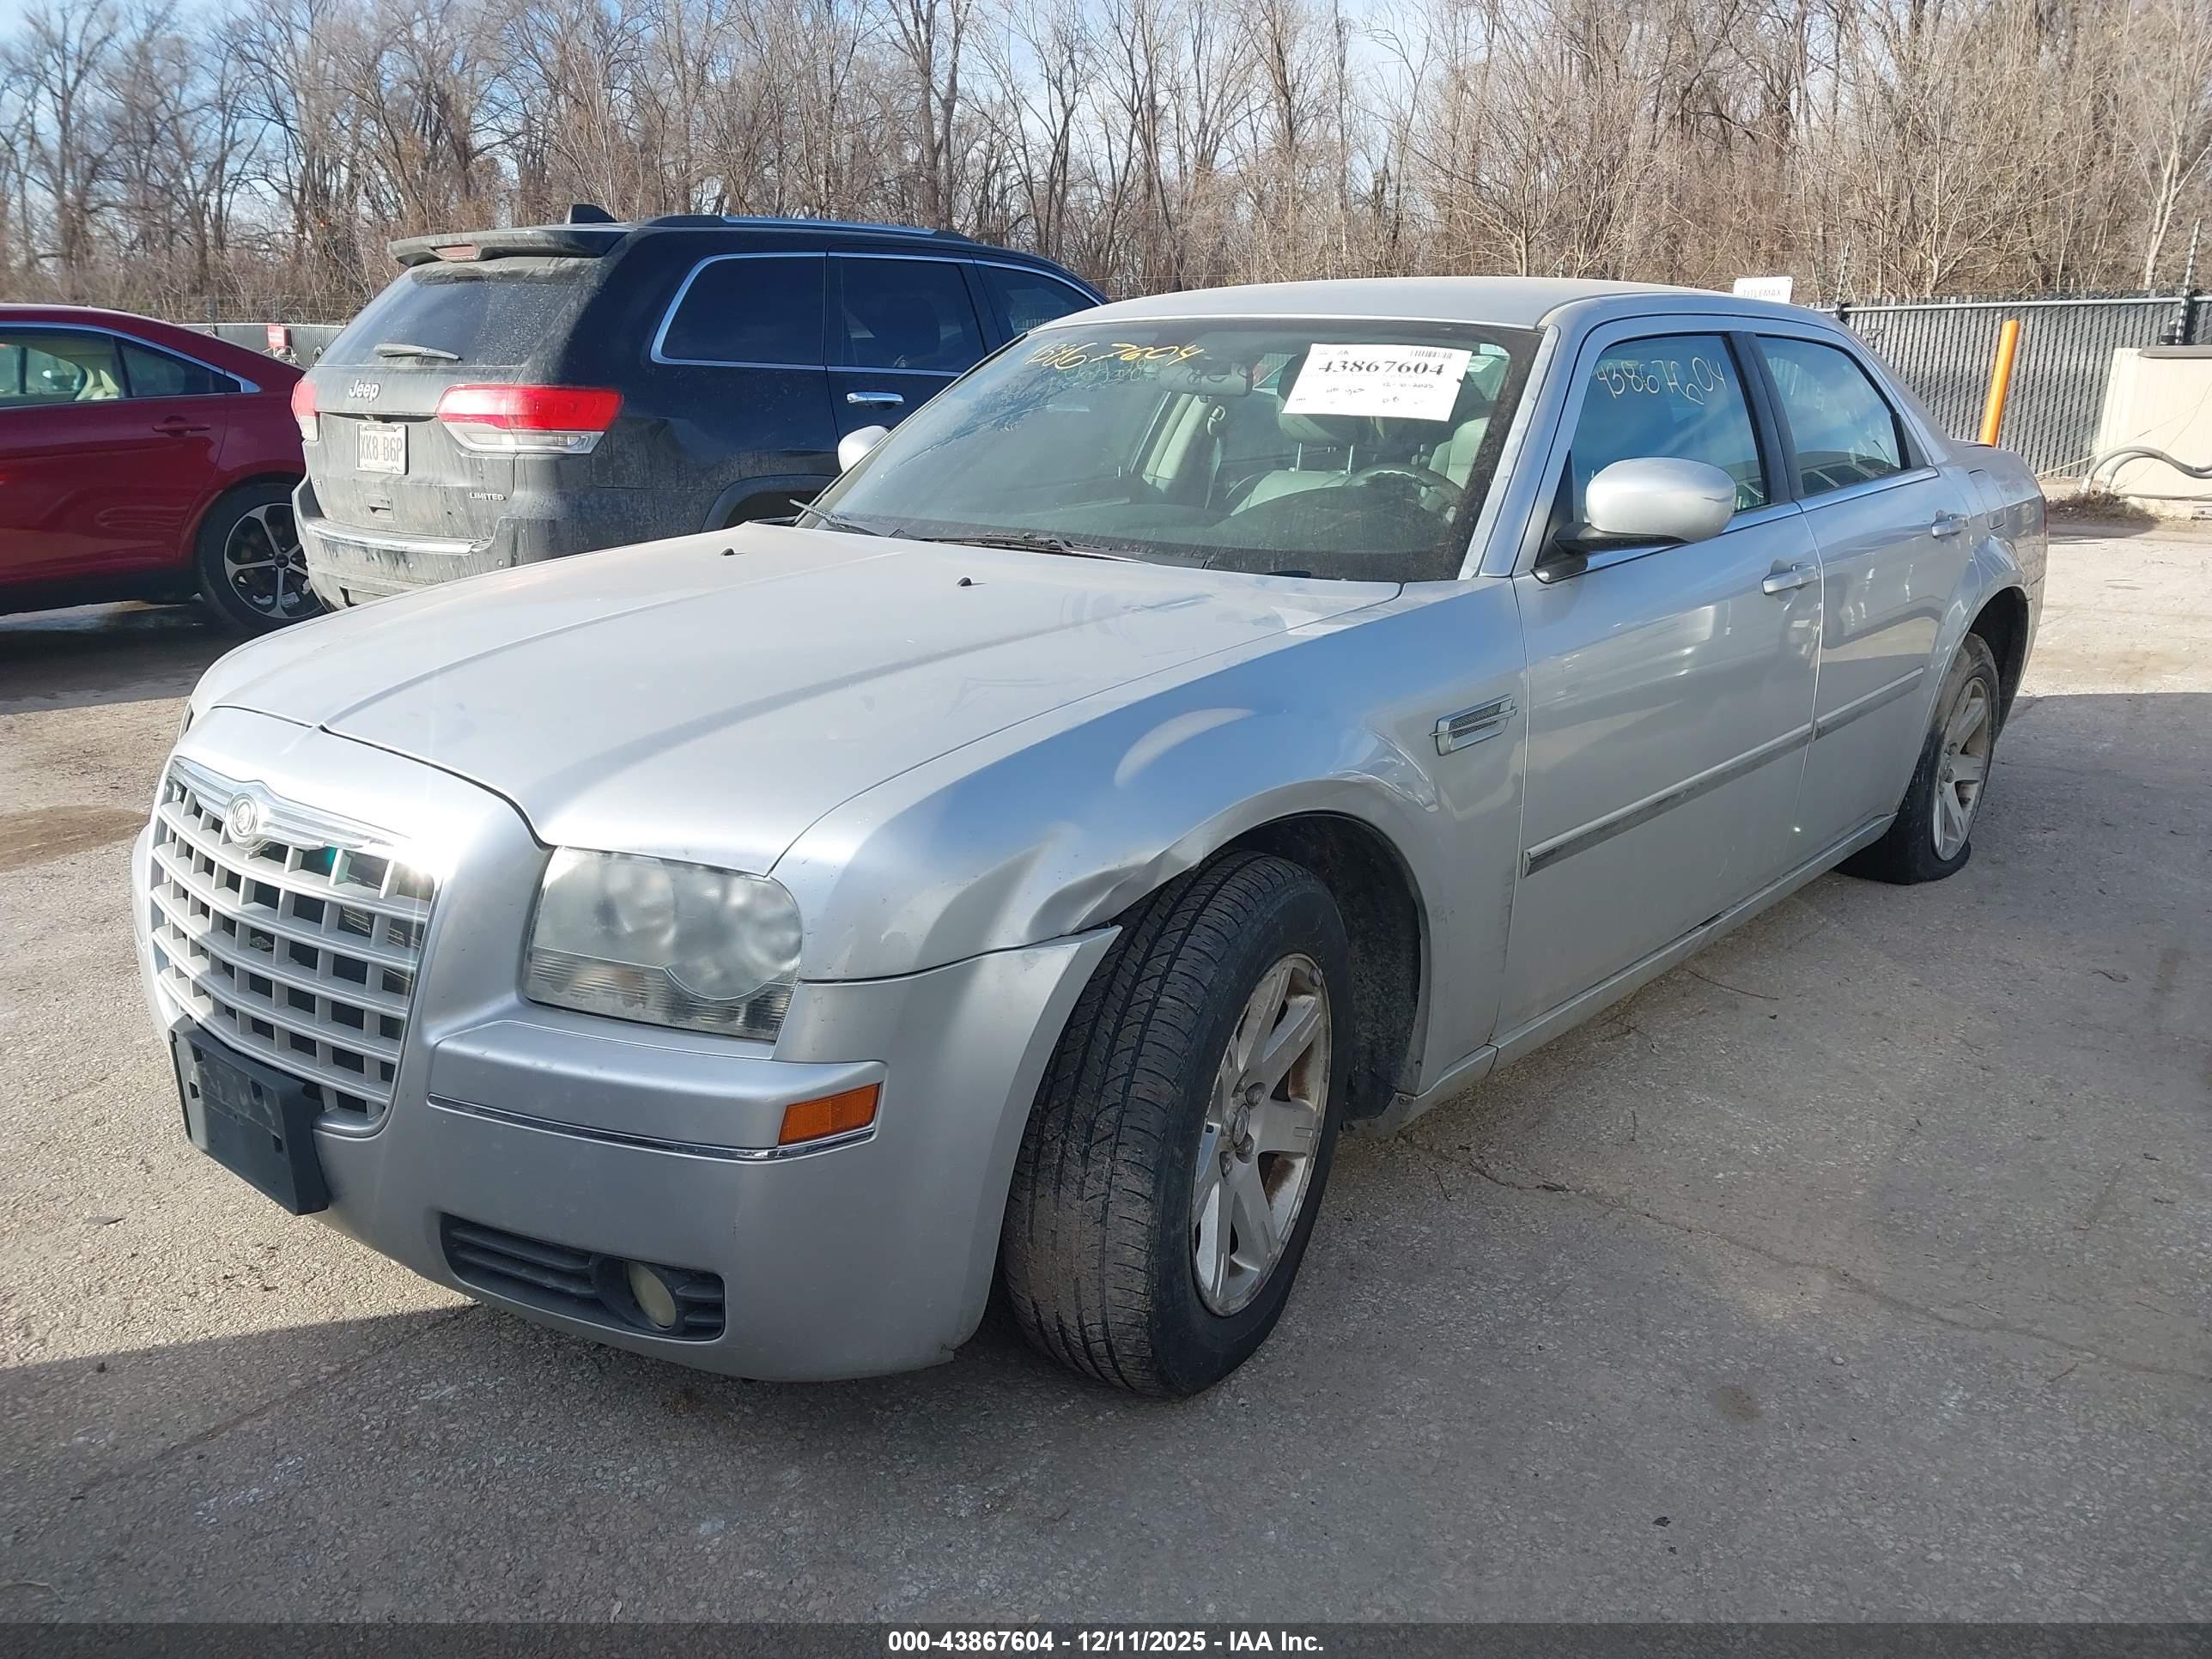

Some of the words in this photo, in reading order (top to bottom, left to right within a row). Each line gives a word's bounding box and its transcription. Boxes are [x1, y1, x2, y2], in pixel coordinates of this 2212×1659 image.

[1318, 360, 1445, 376] 43867604
[349, 378, 380, 403] Jeep
[361, 434, 379, 461] XK8
[383, 436, 403, 463] B6P
[469, 491, 506, 501] LIMITED
